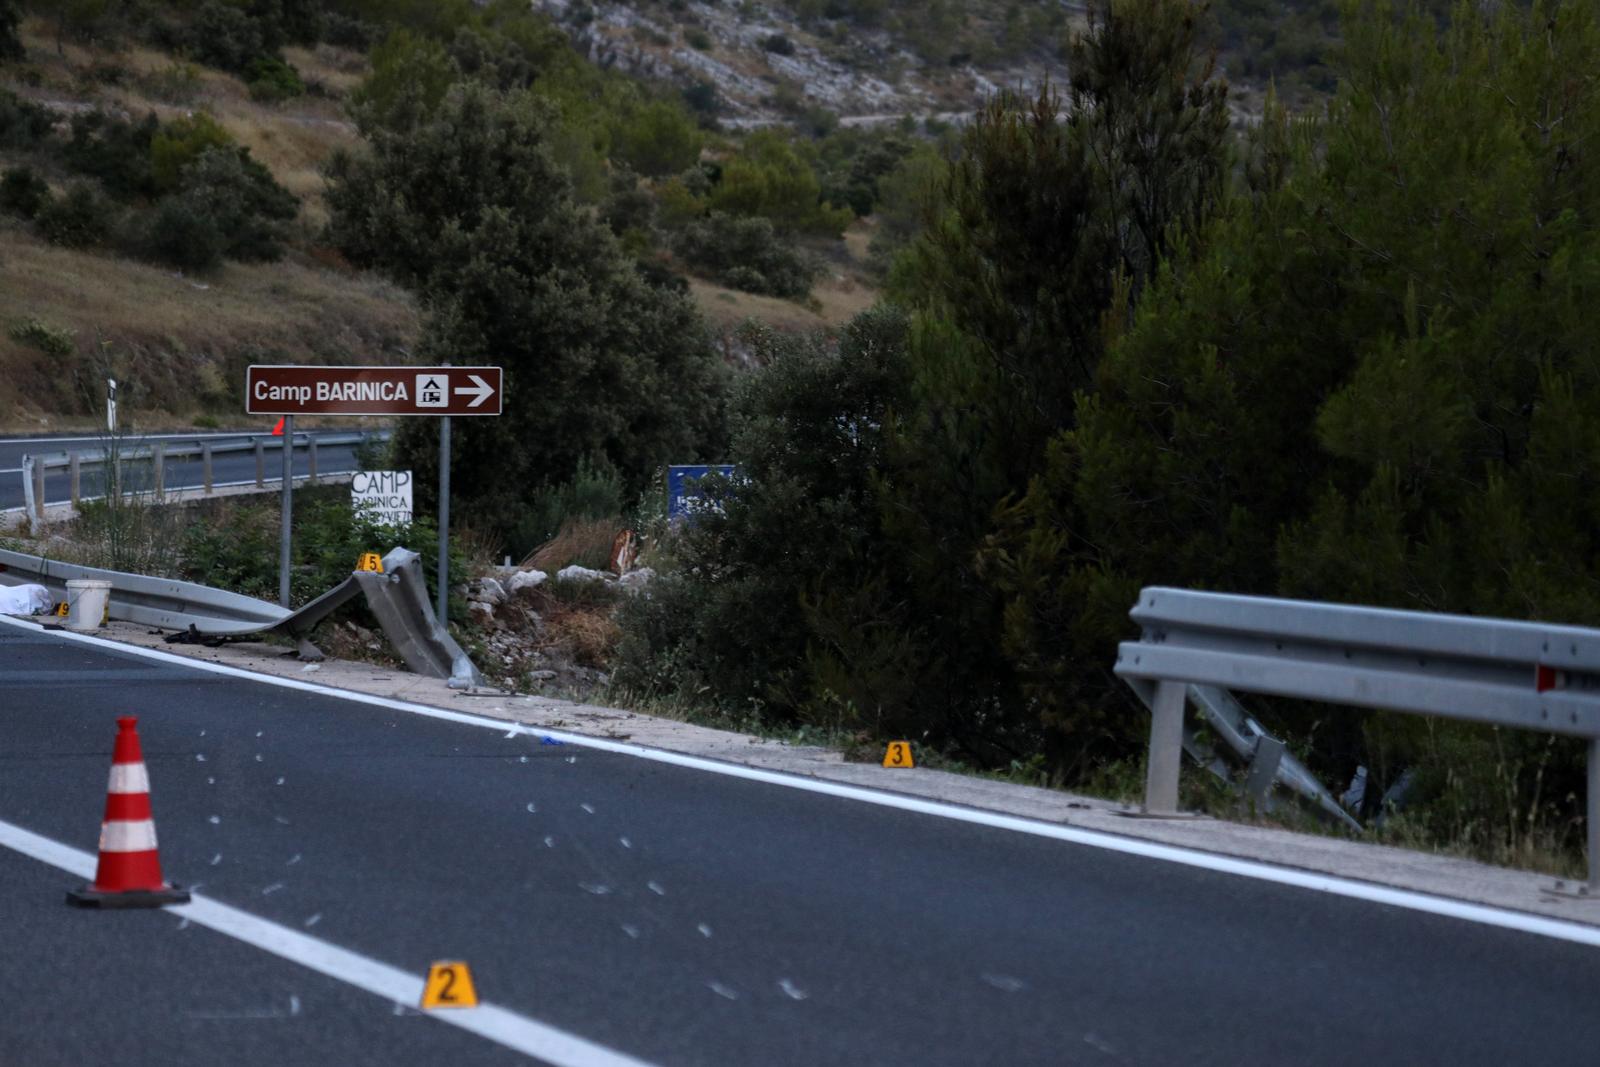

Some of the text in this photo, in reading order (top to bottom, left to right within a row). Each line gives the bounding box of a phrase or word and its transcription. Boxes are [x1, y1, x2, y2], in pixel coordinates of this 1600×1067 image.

[254, 380, 409, 406] Camp BARINICA
[352, 471, 409, 494] CAMP
[369, 555, 377, 571] 5
[892, 744, 903, 765] 3
[437, 967, 458, 1001] 2
